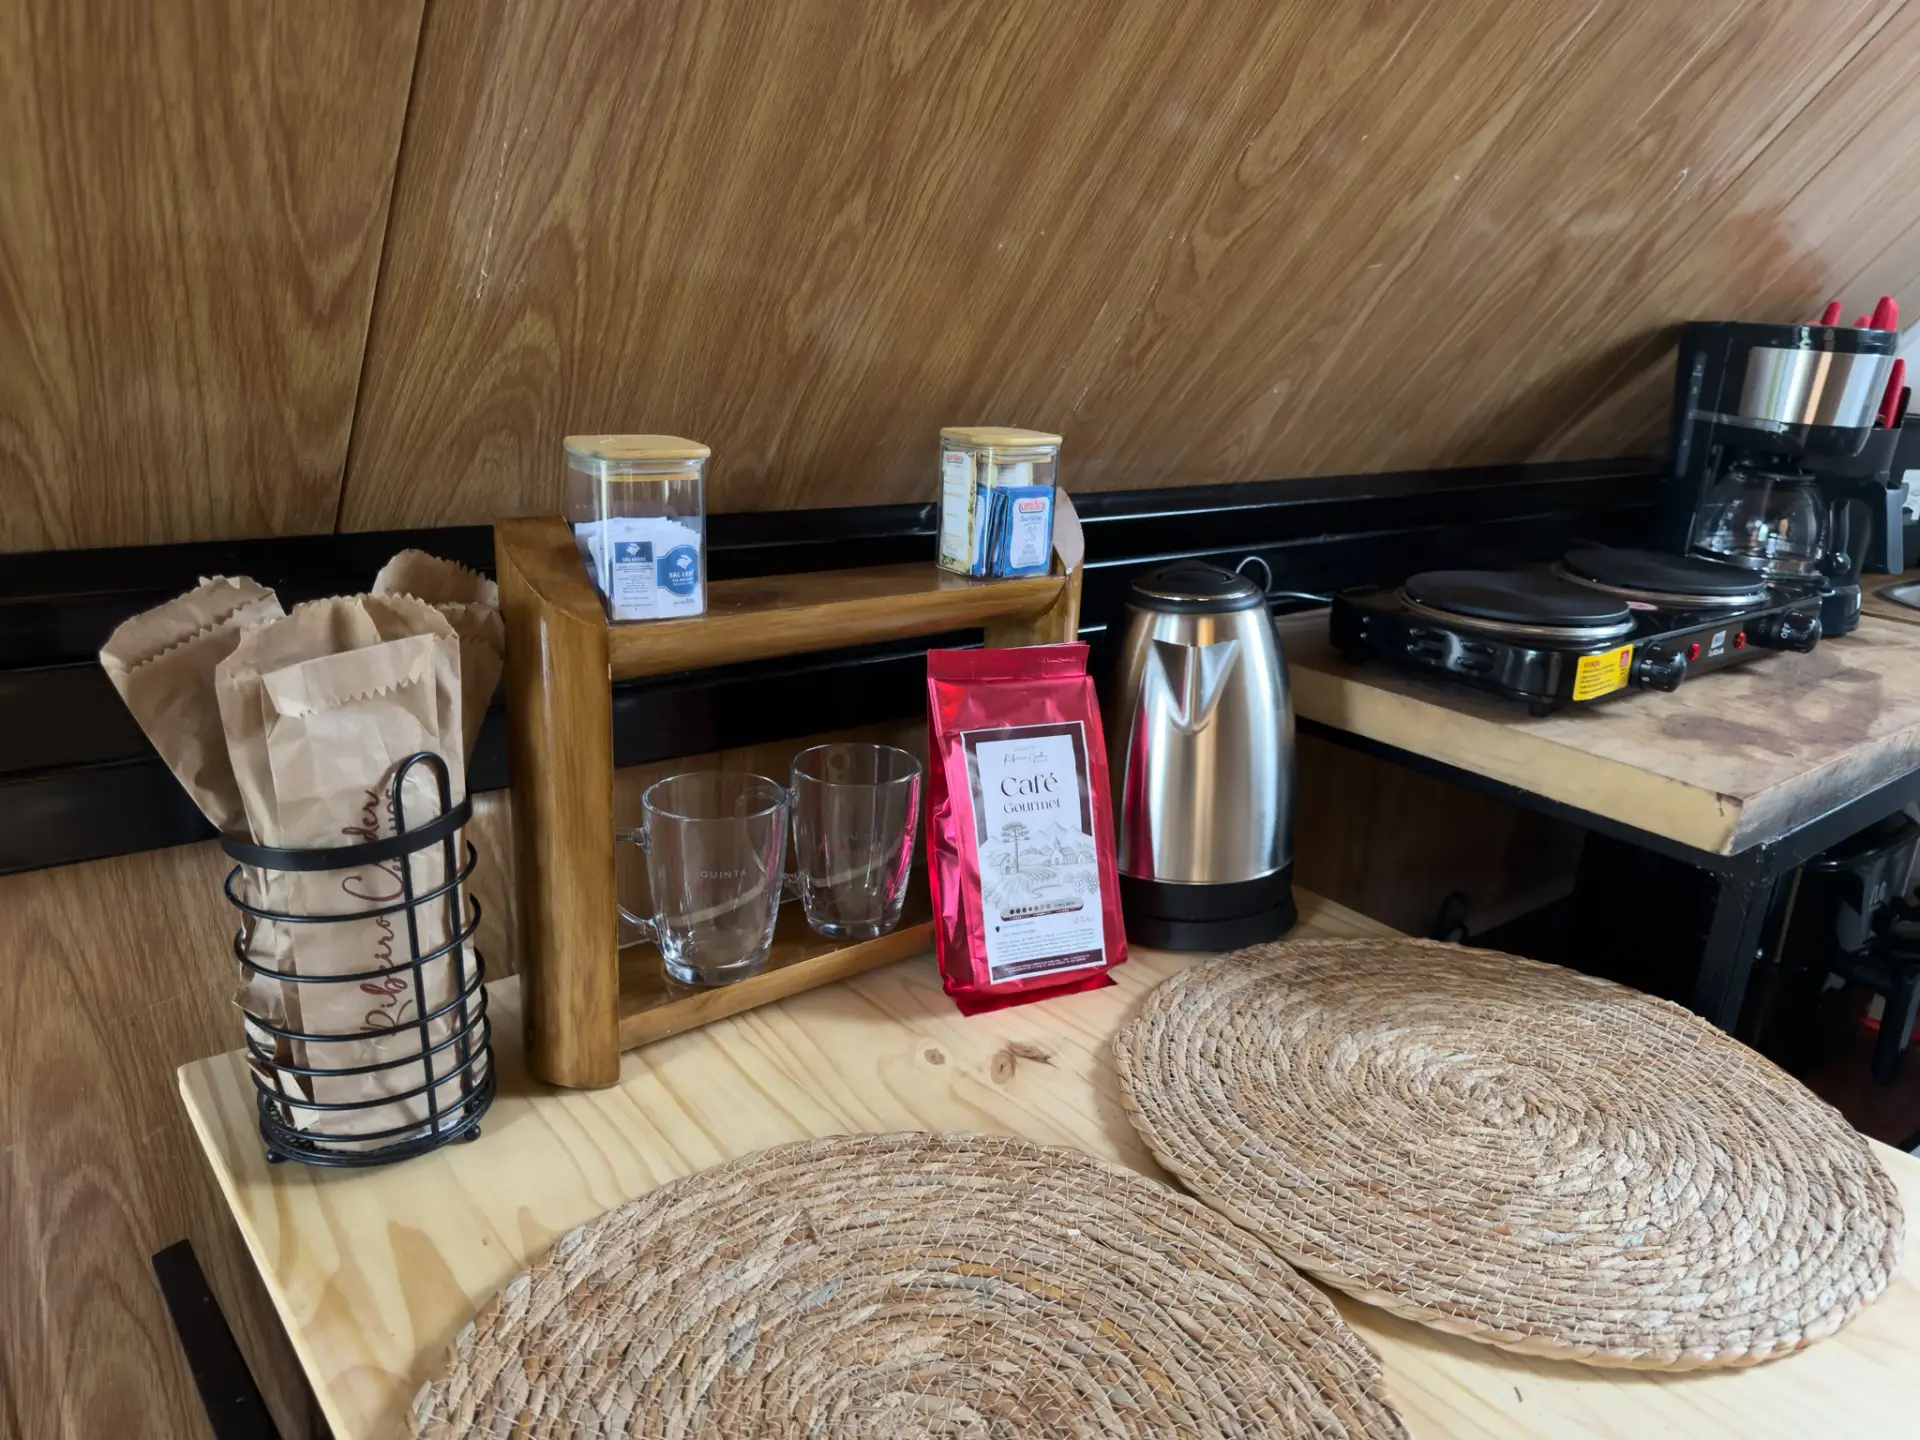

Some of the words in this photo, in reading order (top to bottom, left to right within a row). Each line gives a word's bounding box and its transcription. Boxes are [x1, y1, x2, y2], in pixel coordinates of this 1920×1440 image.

[1780, 622, 1791, 639] OFF
[1001, 772, 1058, 798] Café
[1003, 798, 1061, 814] Gourmet
[700, 868, 747, 879] QUINTA
